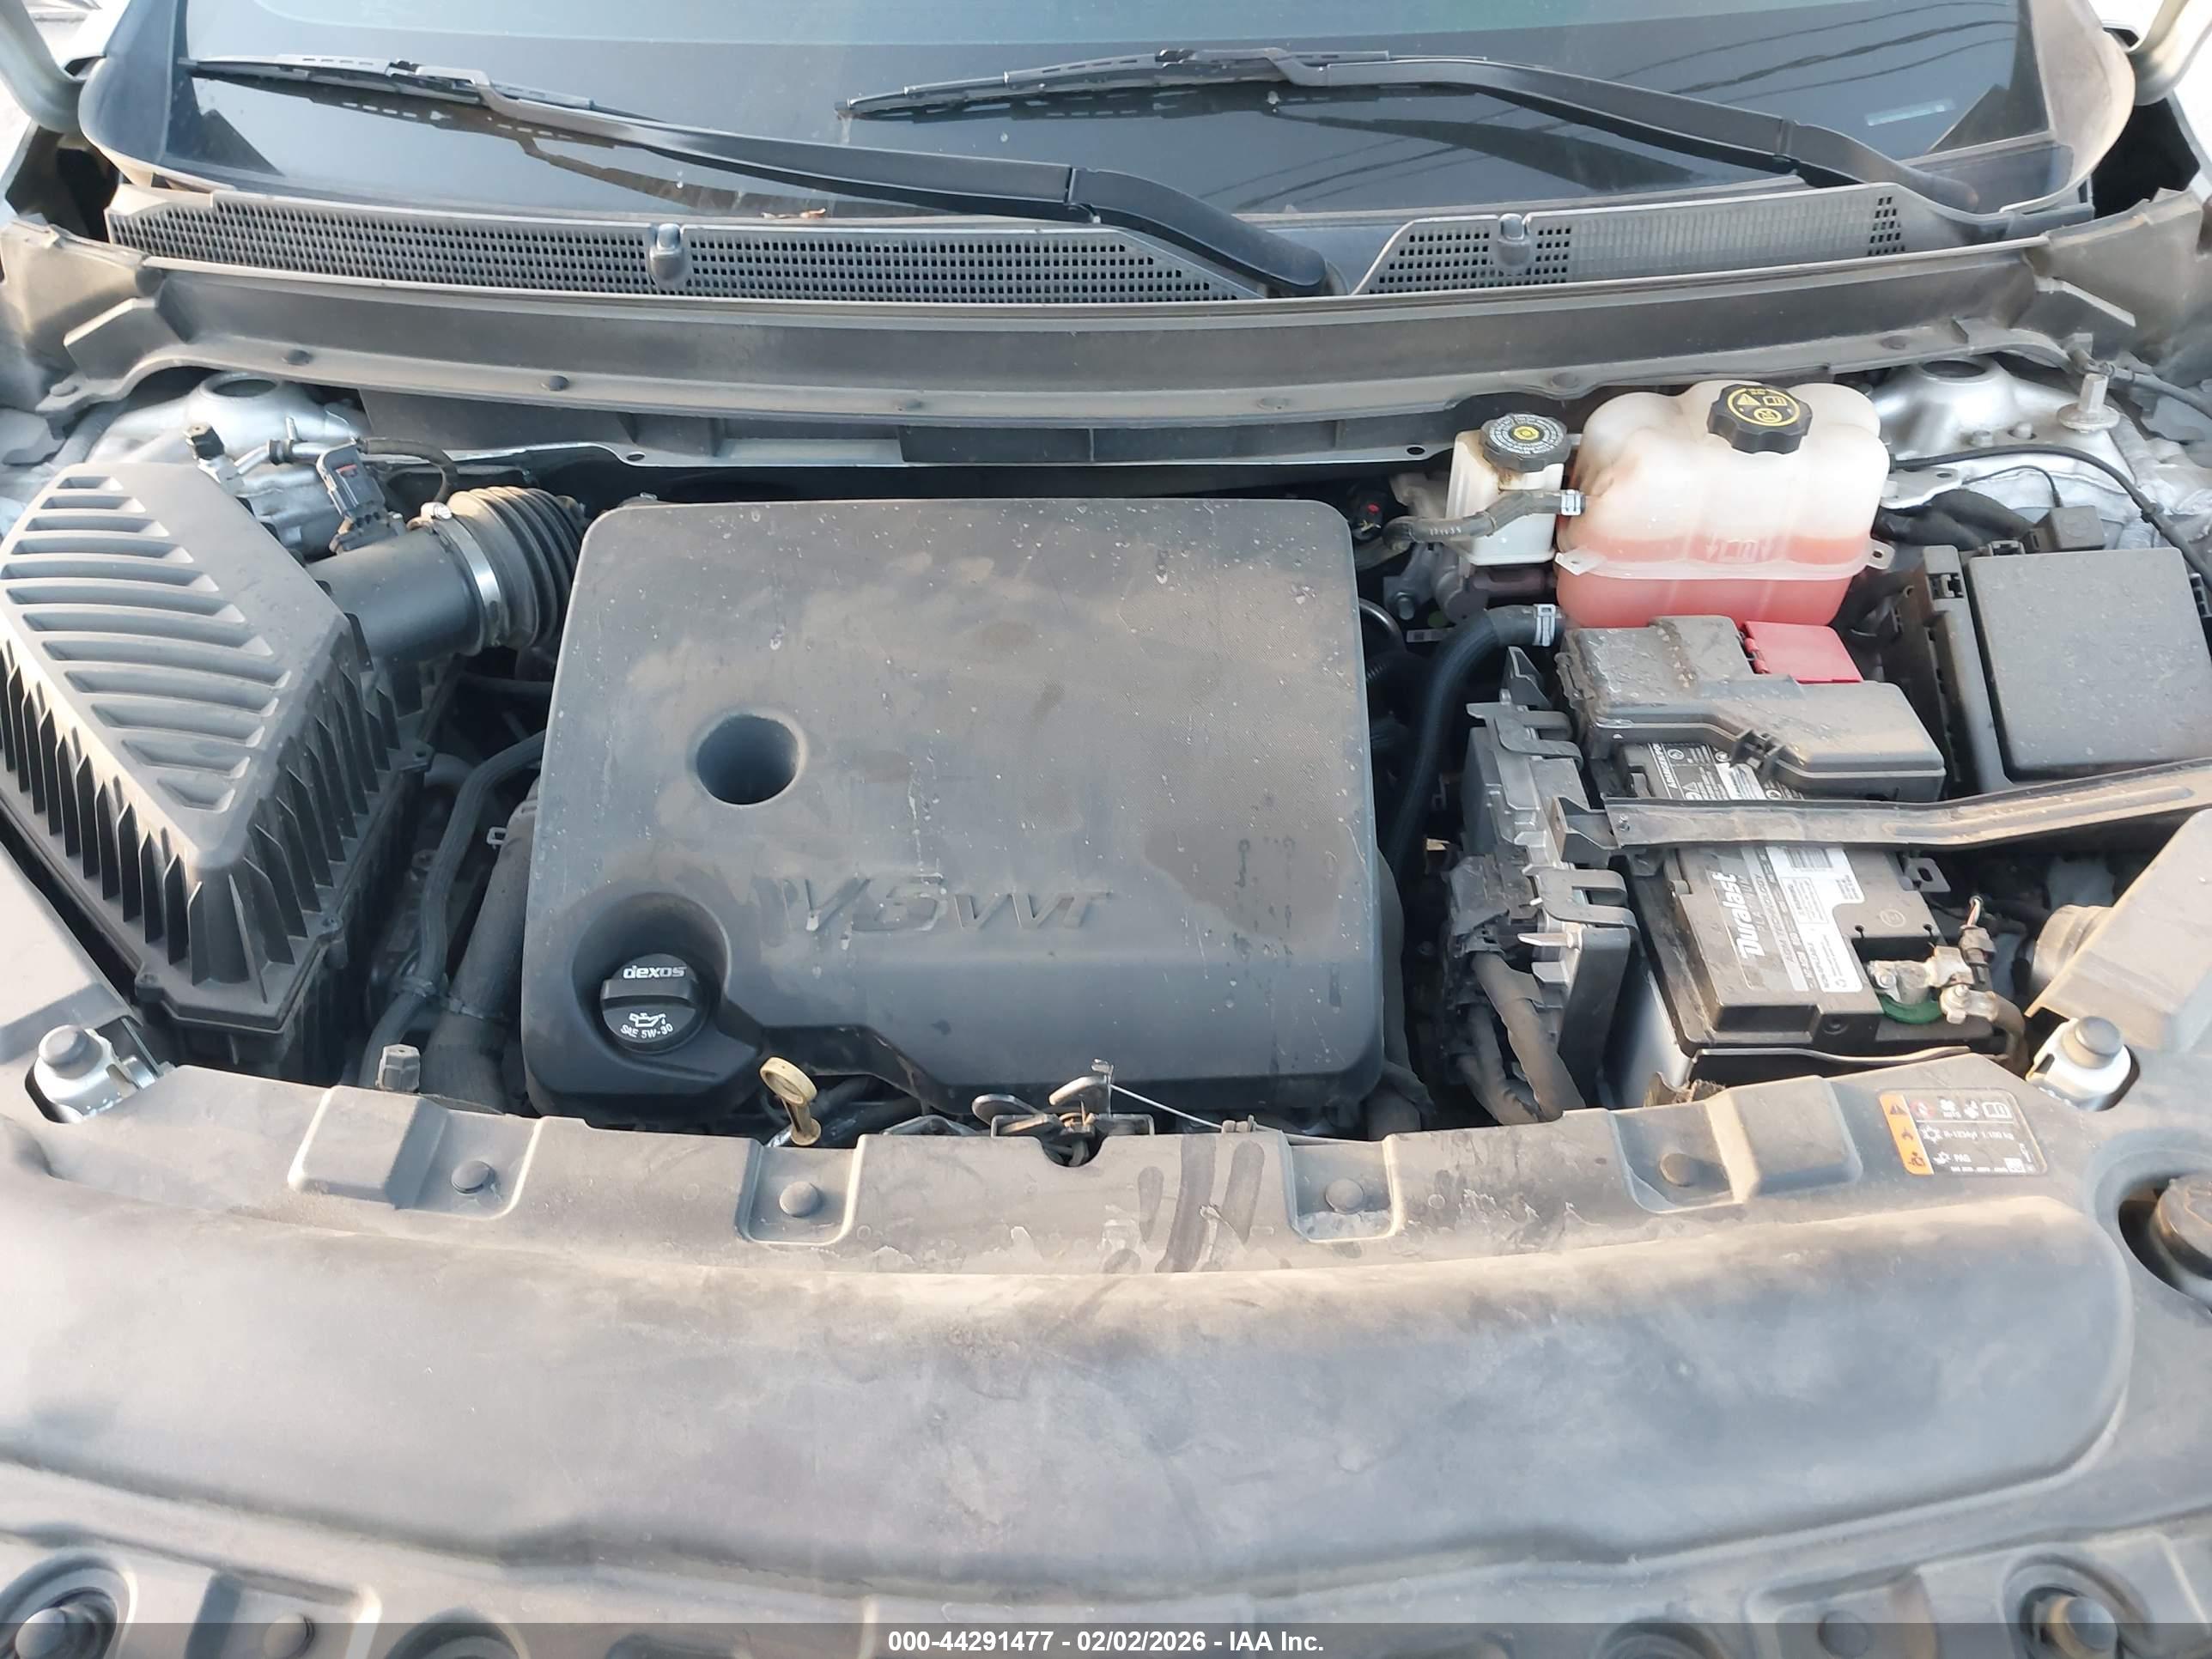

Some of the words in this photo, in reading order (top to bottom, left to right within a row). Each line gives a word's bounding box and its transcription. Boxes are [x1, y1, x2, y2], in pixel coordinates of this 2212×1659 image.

[954, 890, 1113, 930] VVT
[1711, 871, 1765, 959] Duralast
[623, 964, 687, 979] dexos
[620, 1024, 640, 1038] SAE
[641, 1023, 673, 1039] 5W-30
